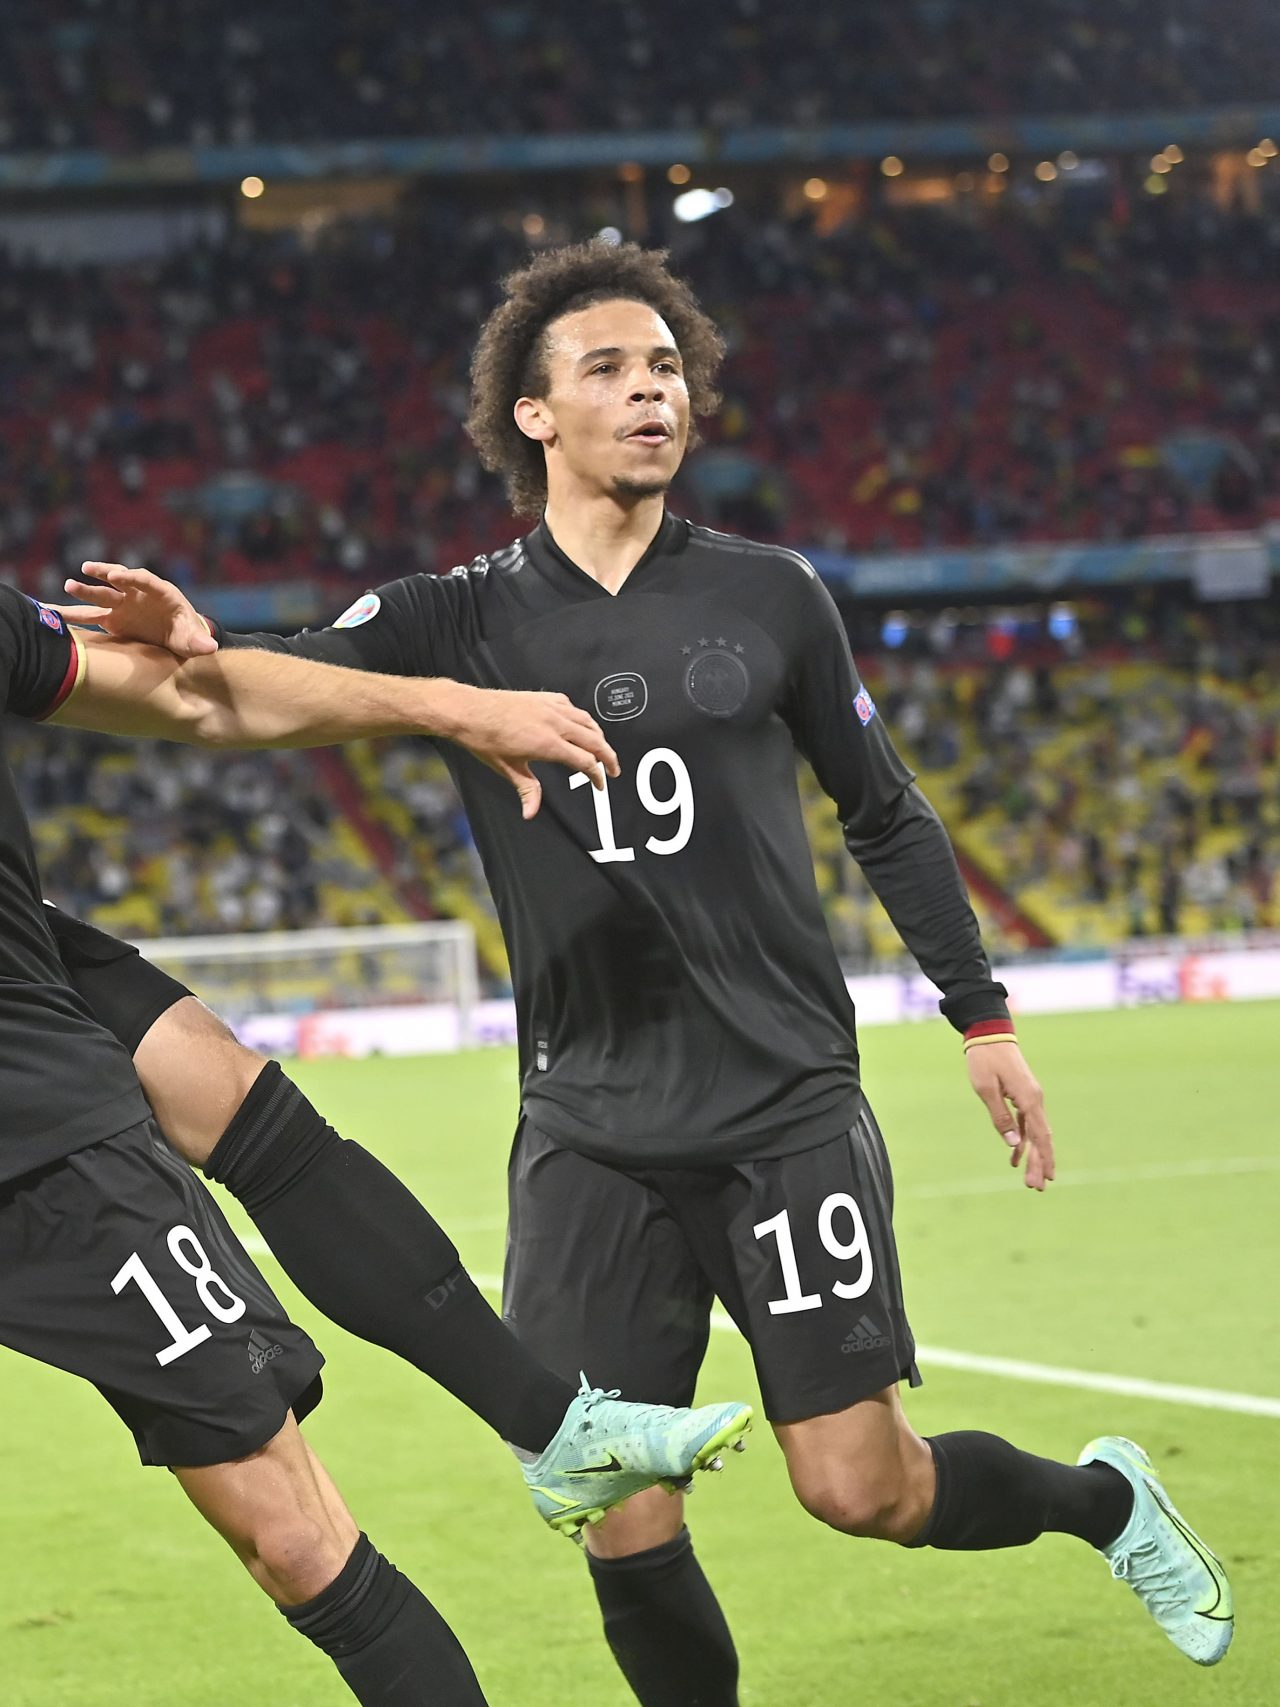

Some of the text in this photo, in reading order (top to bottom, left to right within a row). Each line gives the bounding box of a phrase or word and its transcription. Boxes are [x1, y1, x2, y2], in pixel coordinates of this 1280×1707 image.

[569, 747, 695, 863] 19
[110, 1224, 247, 1367] 18
[753, 1192, 874, 1315] 19
[841, 1336, 892, 1354] adidas
